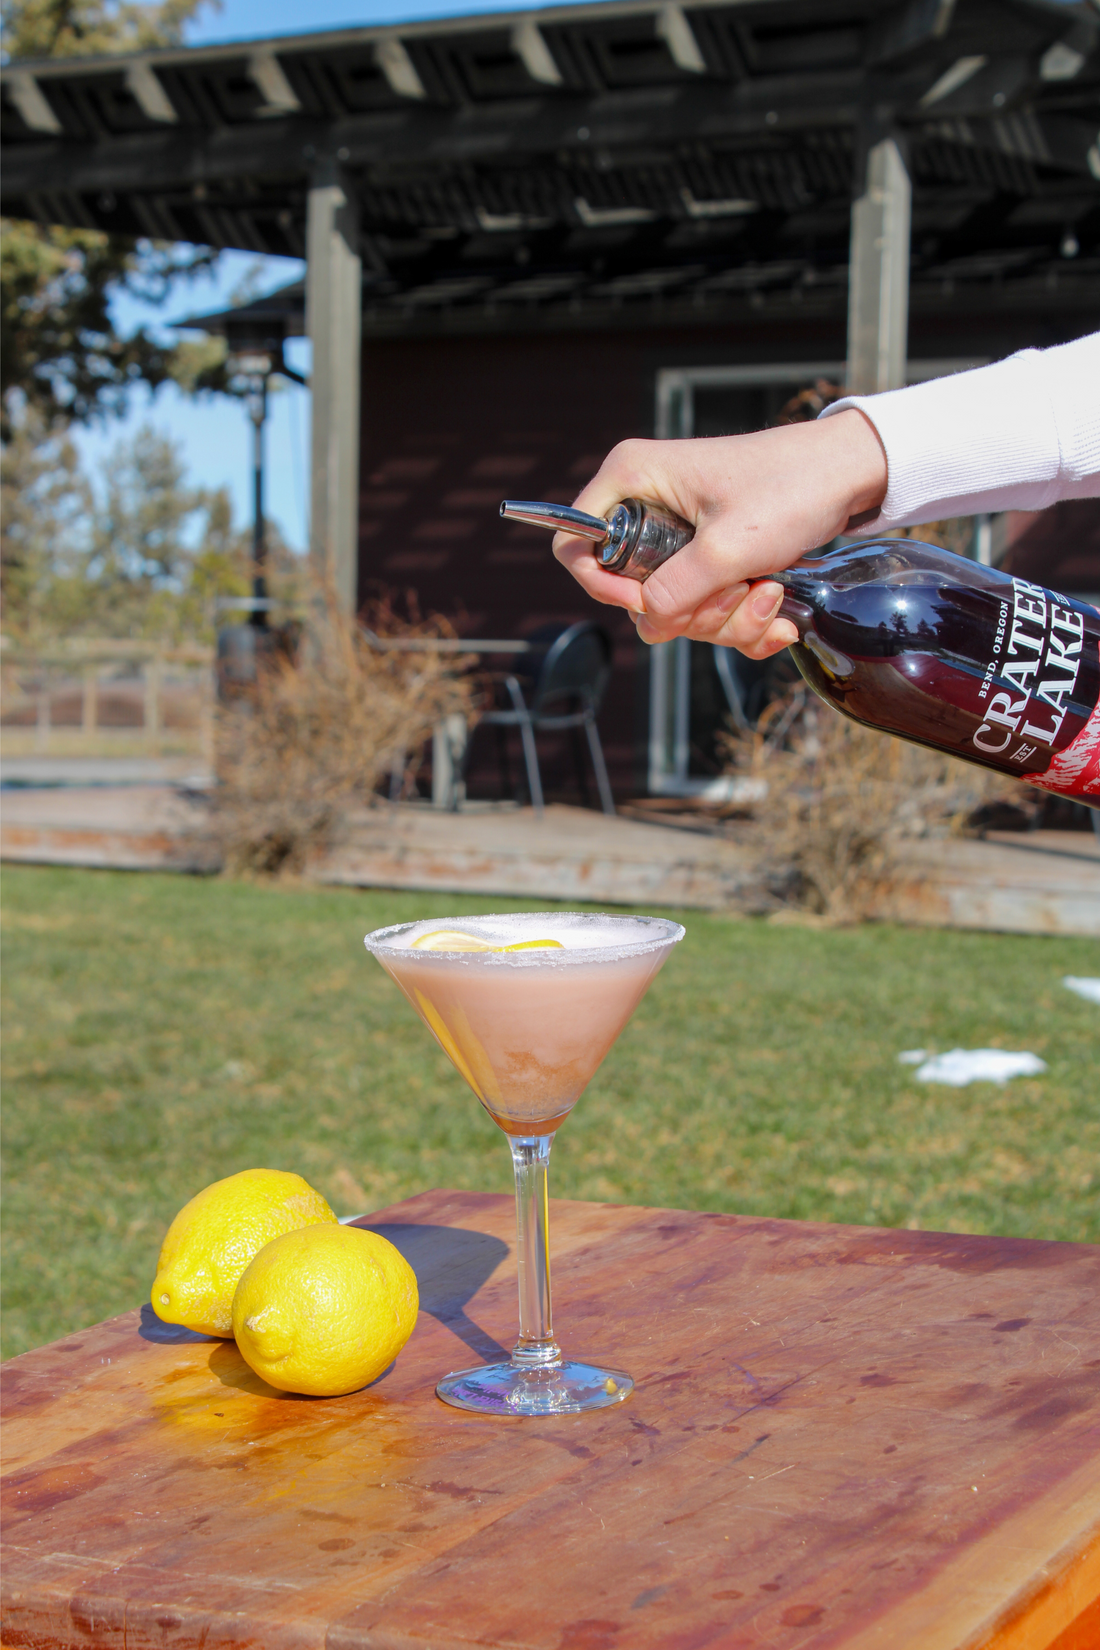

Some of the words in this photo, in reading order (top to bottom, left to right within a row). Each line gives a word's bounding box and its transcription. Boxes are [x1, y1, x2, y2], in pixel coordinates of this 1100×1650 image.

[972, 577, 1047, 753] CRATER
[978, 659, 1000, 699] BEND,
[992, 601, 1009, 654] OREGON
[1019, 603, 1084, 747] LAKE
[1014, 745, 1032, 761] EST
